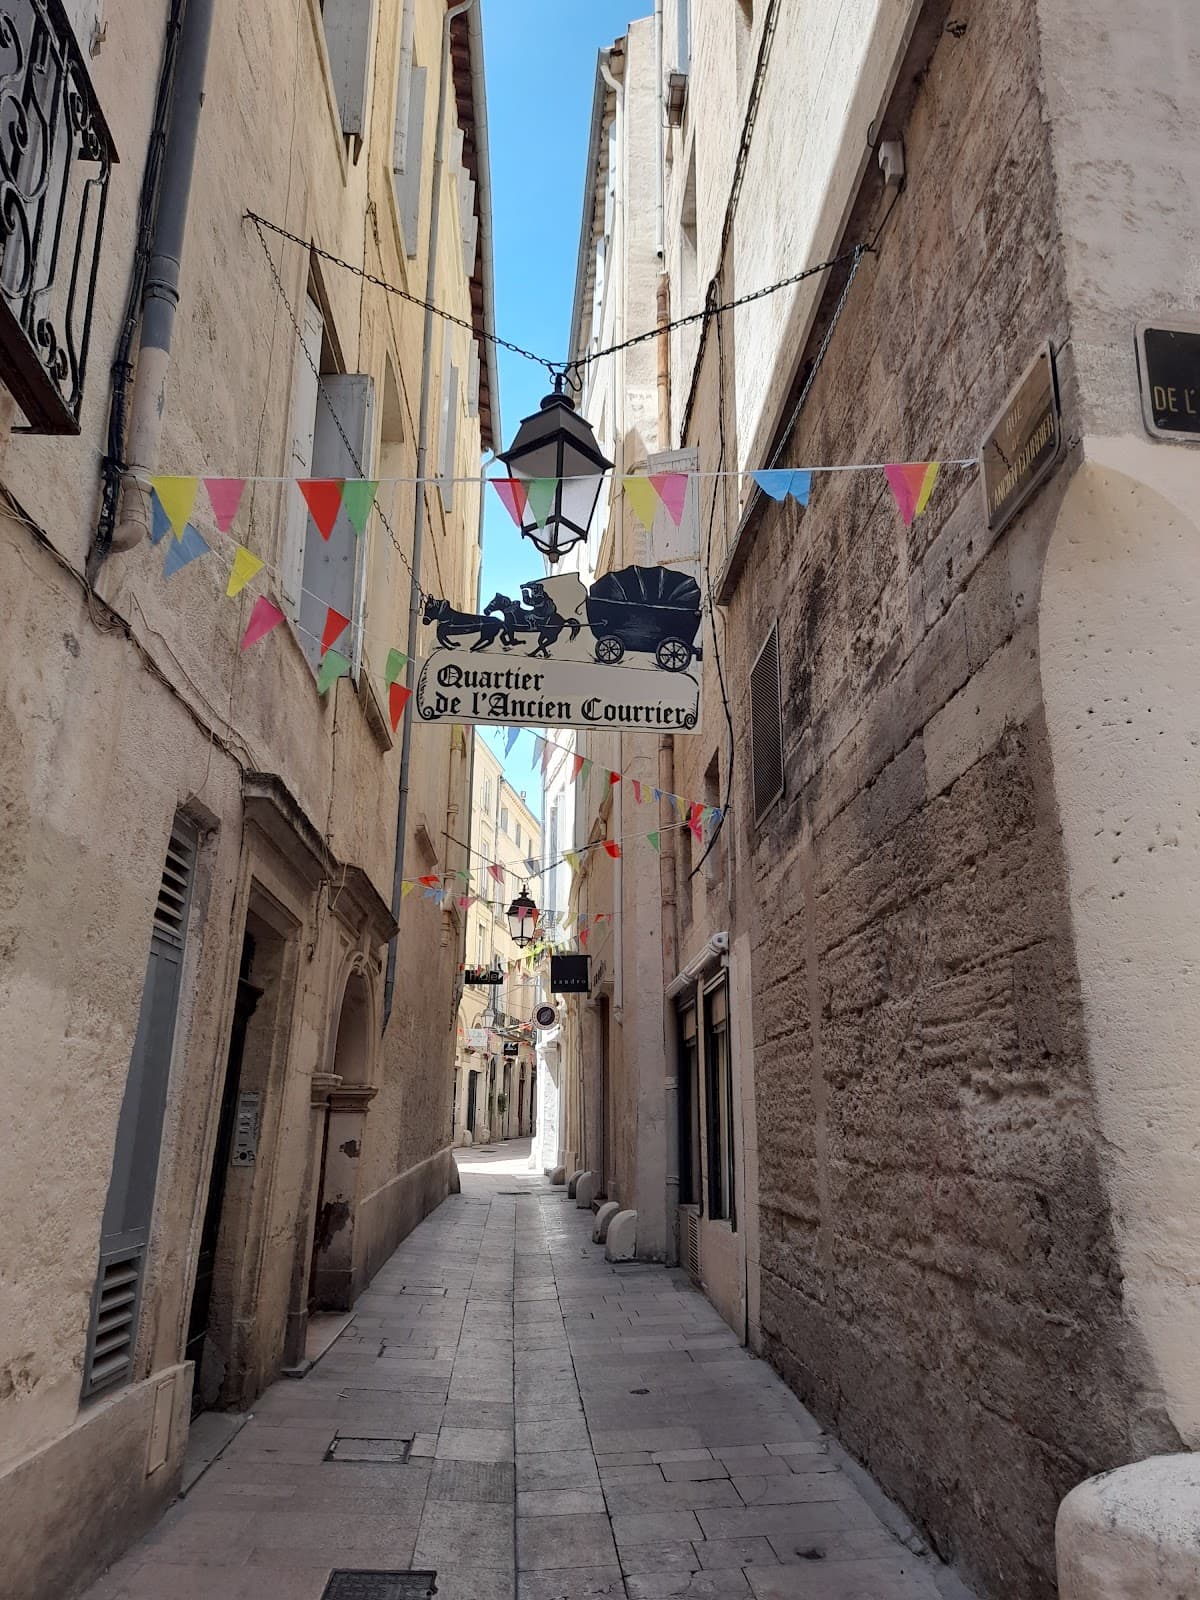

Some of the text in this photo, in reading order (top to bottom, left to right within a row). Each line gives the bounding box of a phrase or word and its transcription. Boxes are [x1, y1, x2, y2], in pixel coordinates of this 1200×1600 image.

[1153, 386, 1178, 412] DE
[437, 664, 545, 691] Quartier
[434, 691, 686, 725] de l'Ancien Courrier
